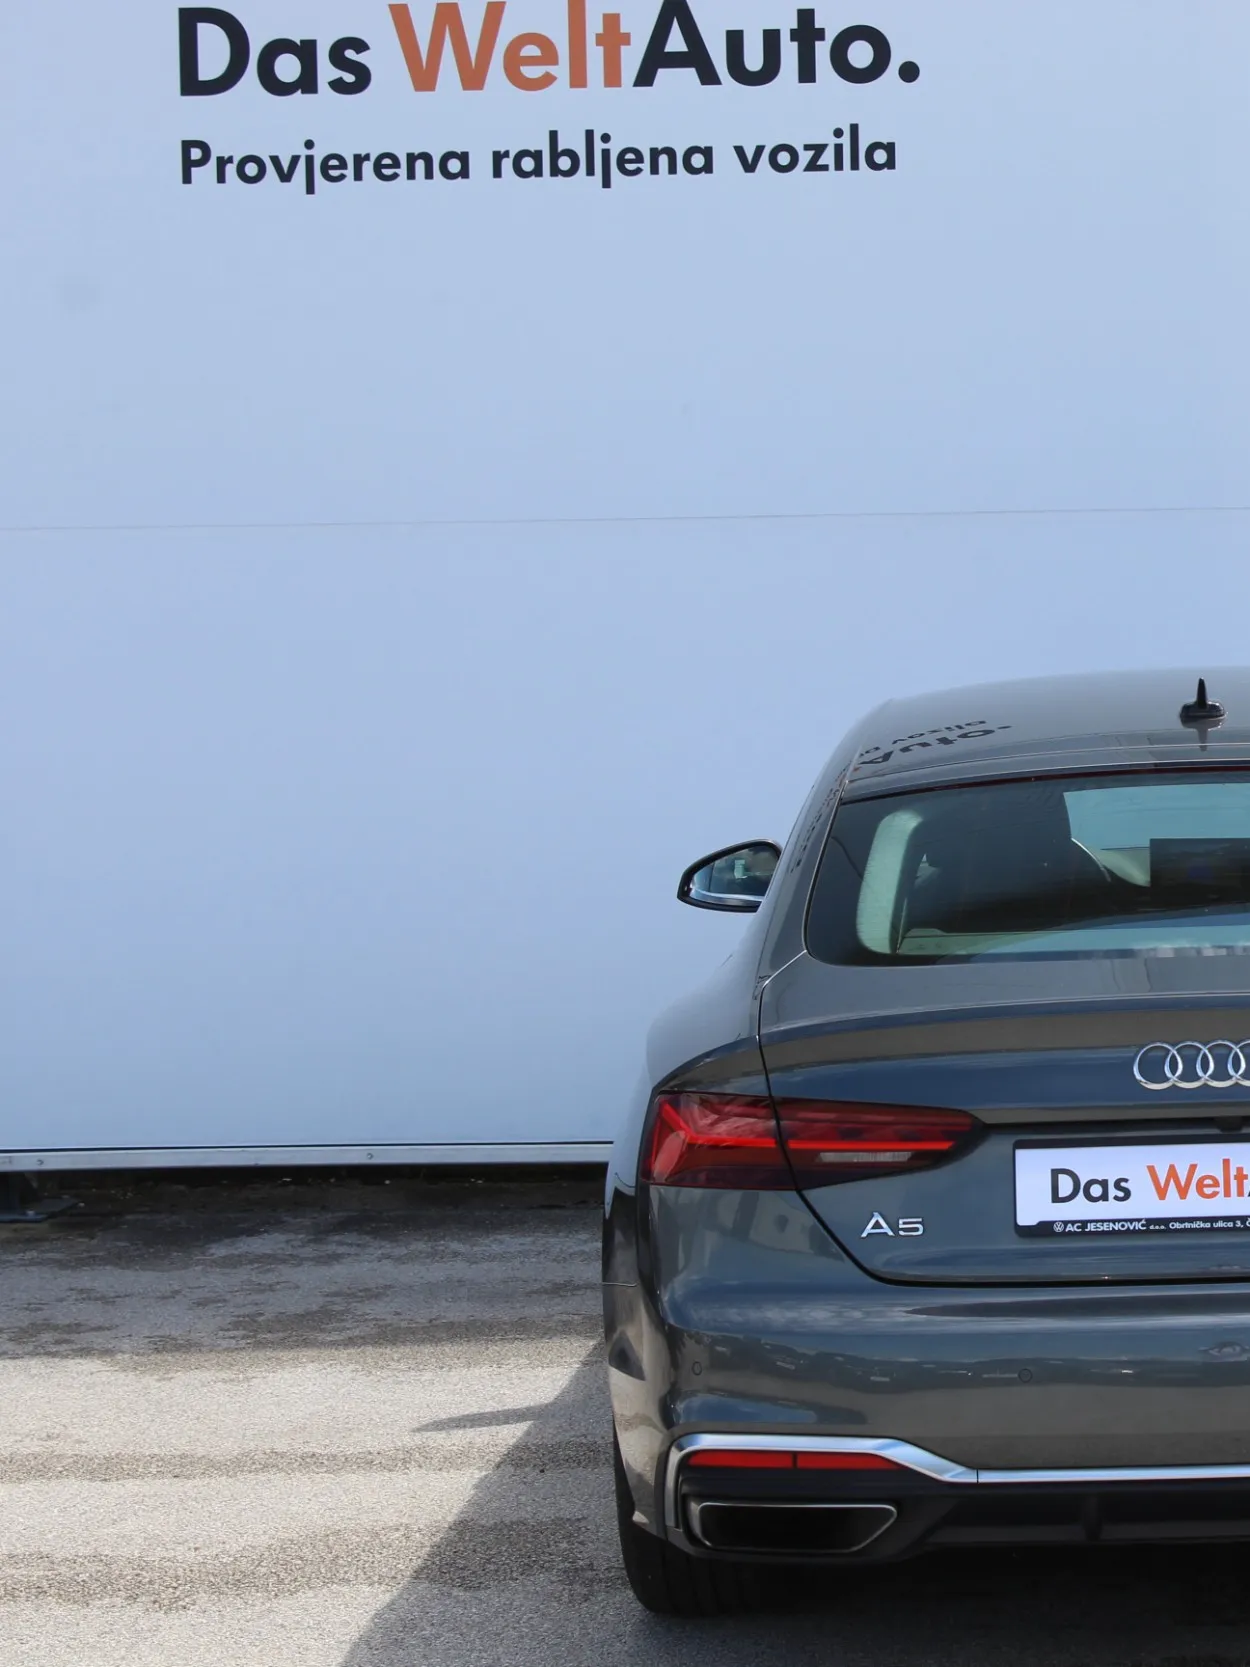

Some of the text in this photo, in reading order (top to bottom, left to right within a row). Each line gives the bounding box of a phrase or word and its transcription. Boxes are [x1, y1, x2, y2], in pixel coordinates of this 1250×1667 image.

[179, 0, 921, 97] Das WeltAuto.
[181, 123, 896, 195] Provjerena rabljena vozila
[1050, 1168, 1132, 1204] Das
[860, 1211, 924, 1238] A5
[1065, 1222, 1082, 1232] AC
[1085, 1219, 1147, 1232] JESENOVIĆ
[1169, 1220, 1211, 1230] Obrtnička
[1213, 1219, 1233, 1228] ulica
